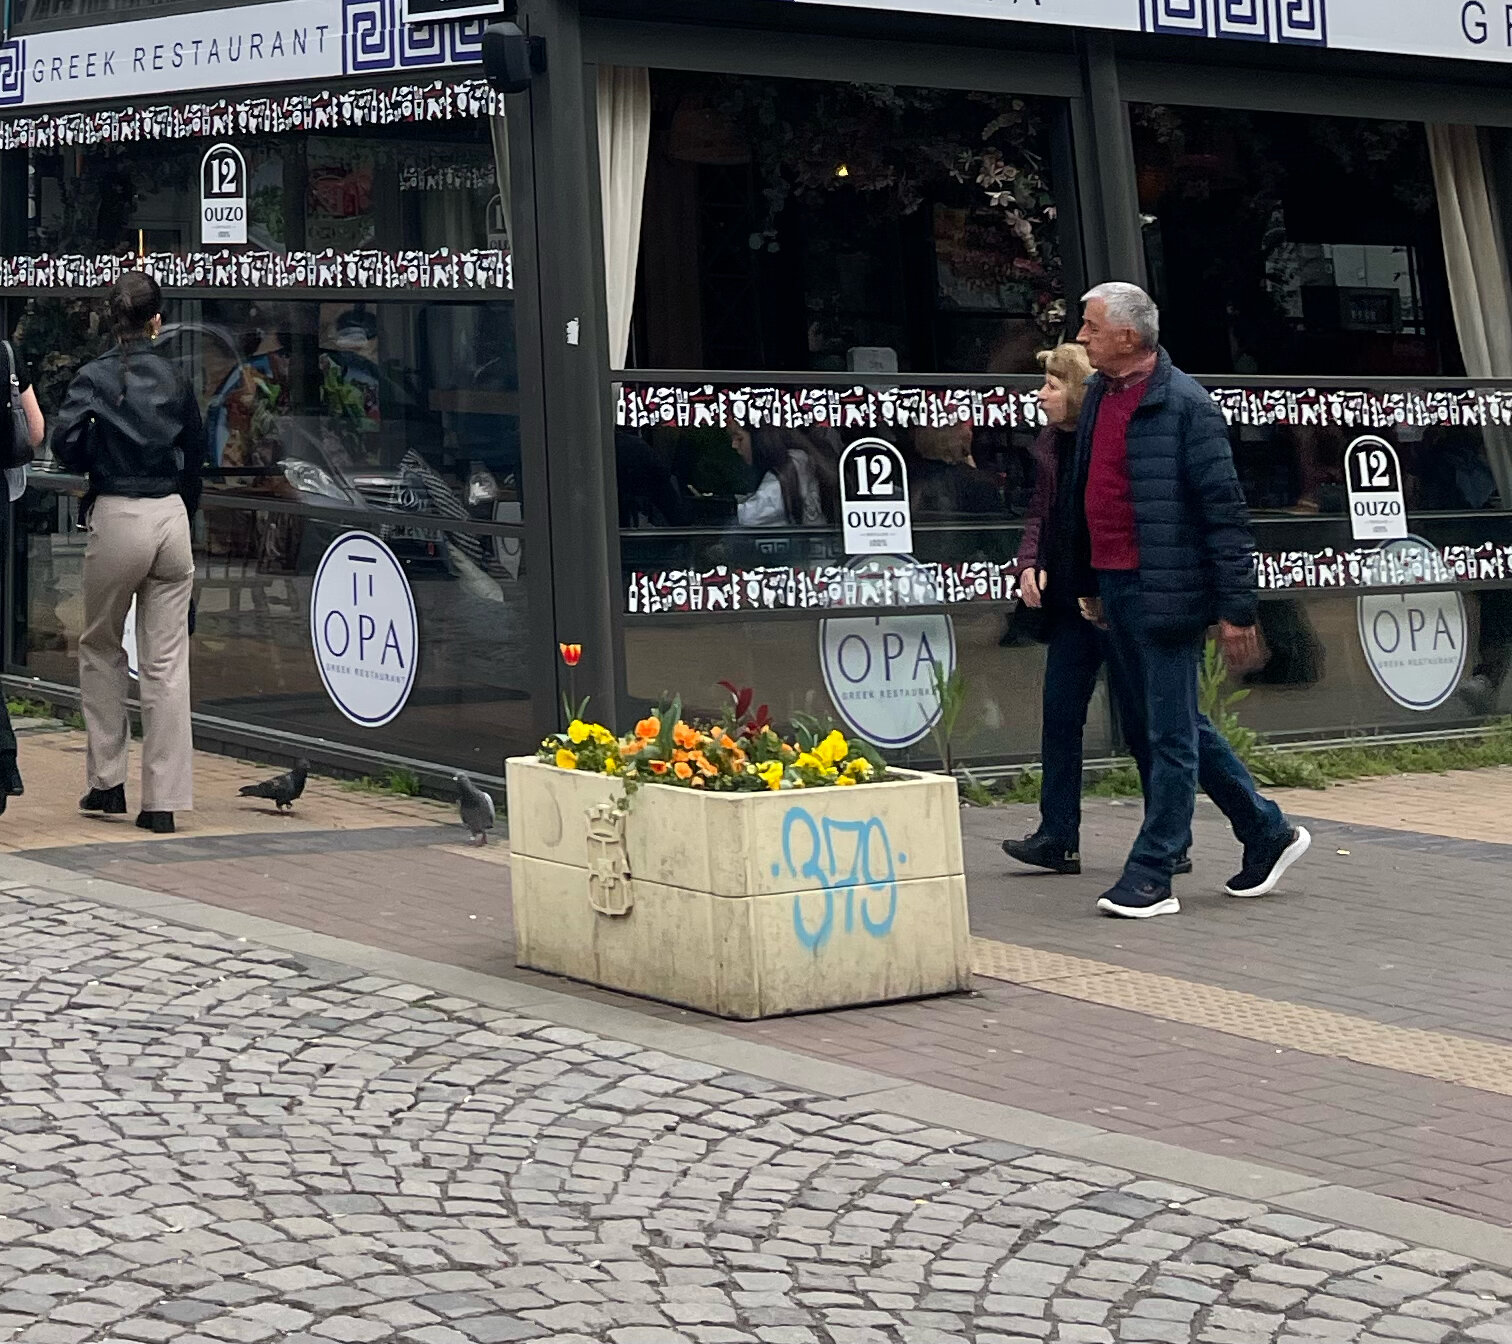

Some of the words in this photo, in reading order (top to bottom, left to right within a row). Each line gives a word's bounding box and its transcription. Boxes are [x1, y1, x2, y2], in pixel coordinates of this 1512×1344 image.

[32, 50, 116, 84] GREEK
[133, 25, 330, 73] RESTAURANT
[210, 157, 237, 194] 12
[204, 206, 244, 222] OUZO
[853, 454, 894, 496] 12
[1355, 450, 1390, 487] 12
[848, 511, 906, 529] OUZO
[1354, 500, 1401, 516] OUZO
[324, 610, 405, 669] OPA
[1373, 607, 1456, 654] OPA
[837, 631, 938, 683] OPA
